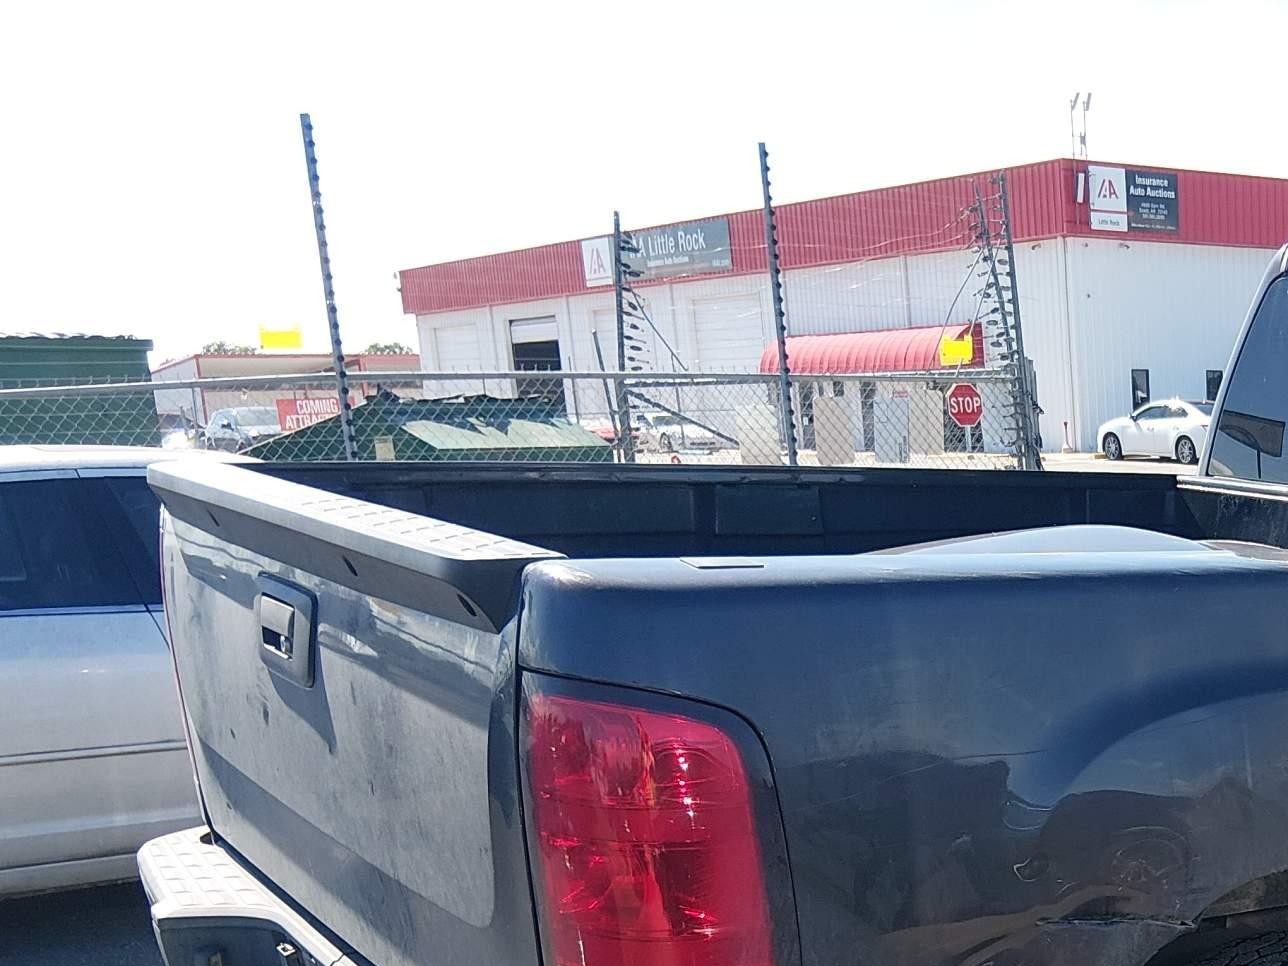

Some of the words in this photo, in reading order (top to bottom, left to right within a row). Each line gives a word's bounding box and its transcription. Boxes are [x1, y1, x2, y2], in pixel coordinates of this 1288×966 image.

[1135, 174, 1169, 187] Insurance
[1129, 184, 1145, 196] Auto
[1146, 186, 1176, 199] Auctions
[647, 234, 675, 257] Little
[677, 228, 706, 252] Rock
[296, 398, 338, 414] COMING
[950, 396, 981, 414] STOP
